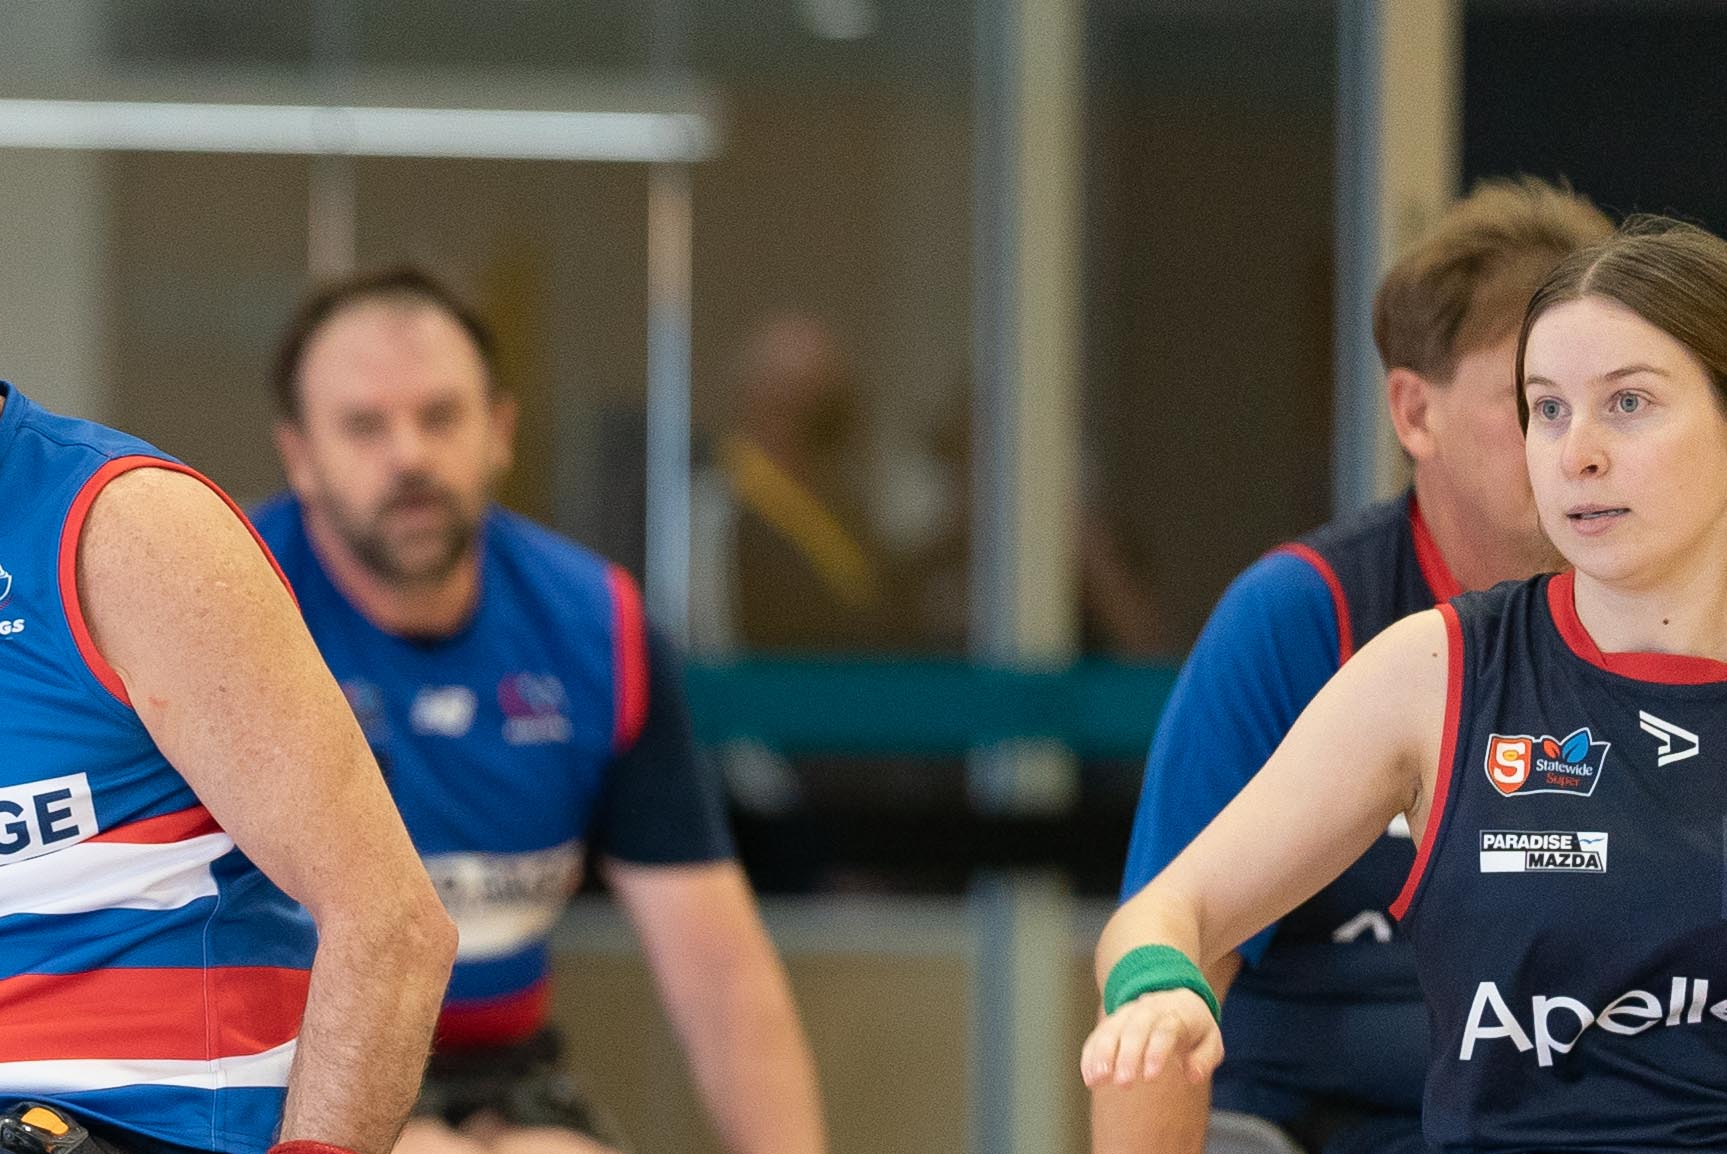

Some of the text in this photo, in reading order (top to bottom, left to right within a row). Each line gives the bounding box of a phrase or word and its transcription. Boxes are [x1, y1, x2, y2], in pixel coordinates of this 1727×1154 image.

[1536, 759, 1593, 776] Statewide
[1546, 772, 1580, 788] Super
[1483, 834, 1572, 850] PARADISE
[1528, 853, 1599, 869] MAZDA
